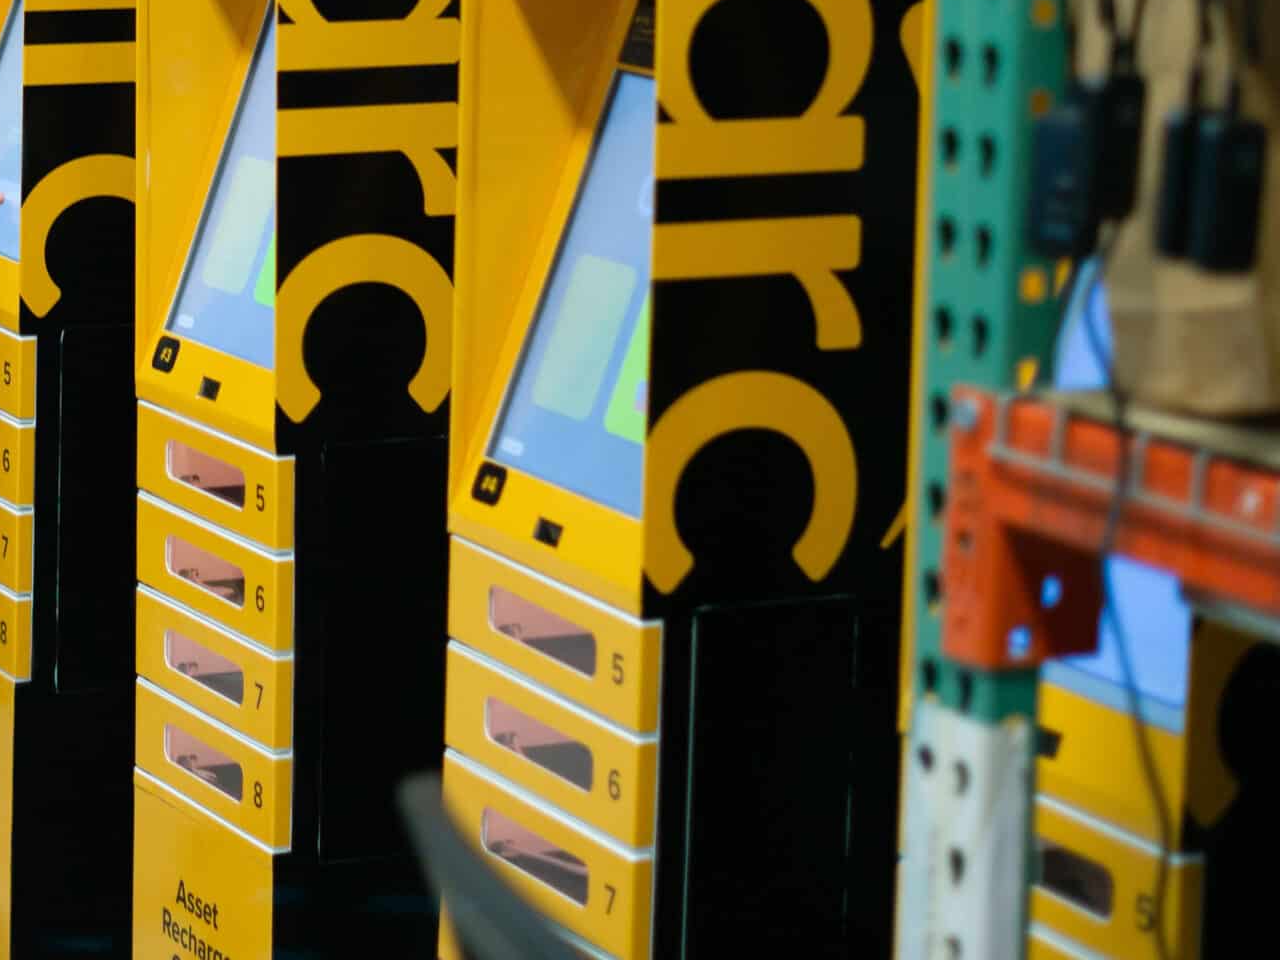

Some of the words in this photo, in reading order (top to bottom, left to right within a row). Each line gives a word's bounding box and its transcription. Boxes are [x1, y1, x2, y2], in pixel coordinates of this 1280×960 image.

[3, 360, 12, 386] 5
[2, 448, 11, 473] 6
[255, 483, 265, 513] 5
[1, 535, 9, 559] 7
[255, 585, 265, 613] 6
[0, 620, 8, 645] 8
[611, 652, 625, 686] 5
[254, 682, 264, 710] 7
[253, 781, 263, 809] 8
[607, 768, 621, 801] 6
[176, 879, 219, 932] Asset
[604, 883, 617, 915] 7
